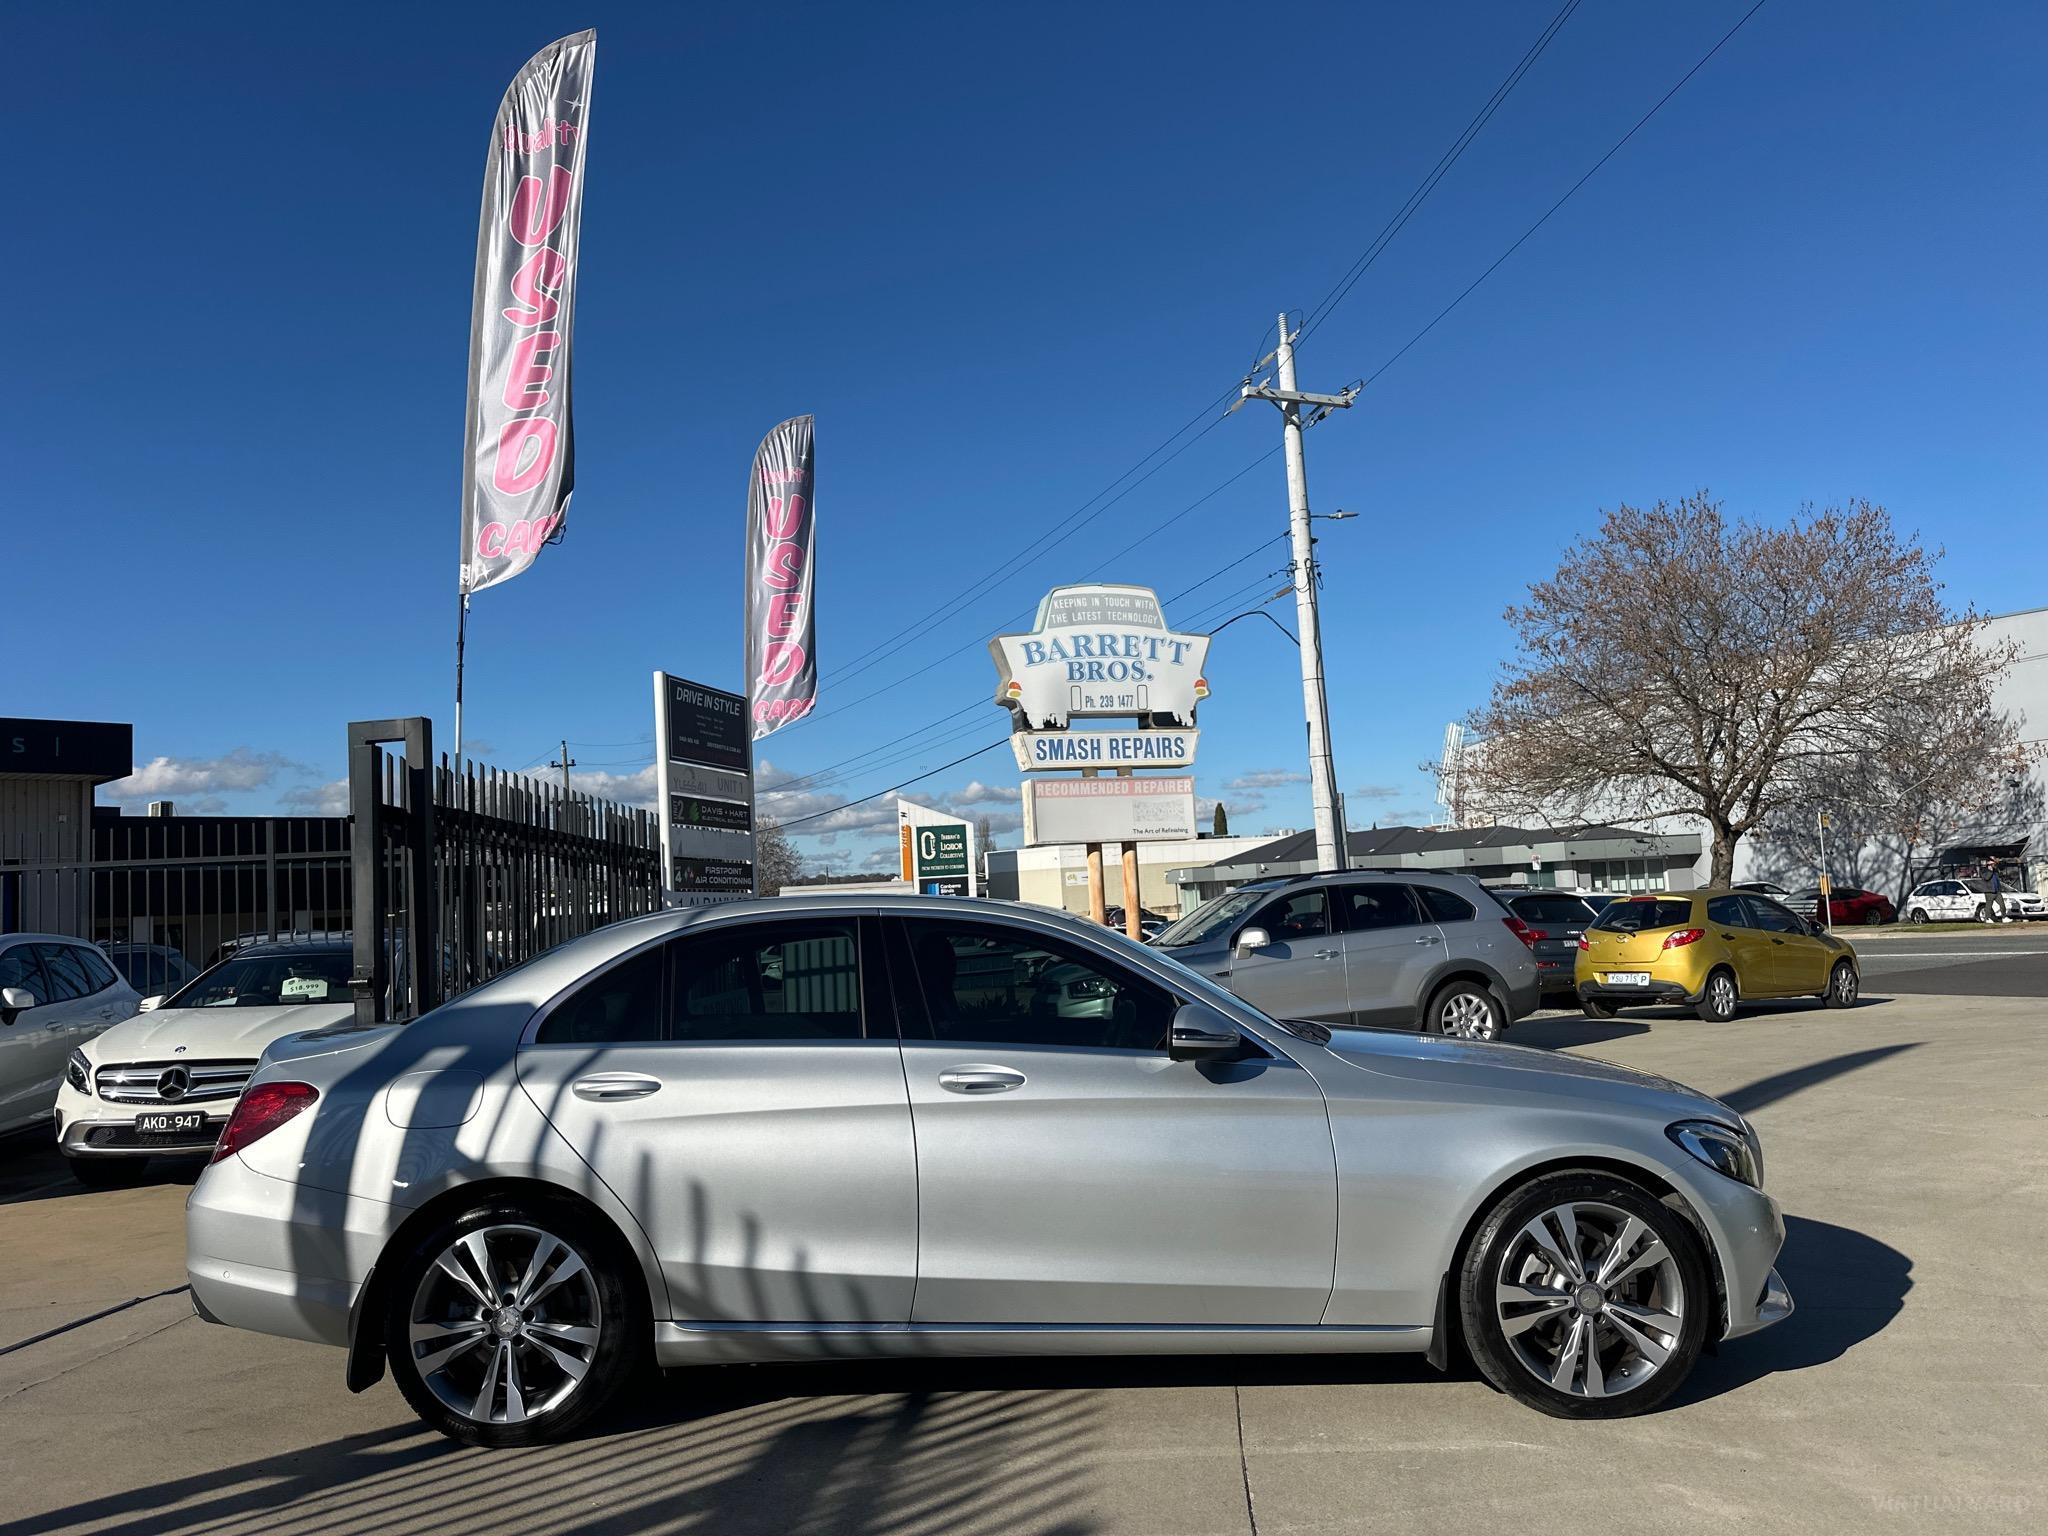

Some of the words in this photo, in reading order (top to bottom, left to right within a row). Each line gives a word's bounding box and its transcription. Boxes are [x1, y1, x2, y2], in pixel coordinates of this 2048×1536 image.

[493, 164, 573, 497] USED
[762, 494, 806, 686] USED
[1054, 597, 1087, 609] KEEPING
[1092, 597, 1100, 606] IN
[1104, 597, 1130, 608] TOUCH
[1135, 600, 1154, 610] WITH
[1051, 613, 1067, 624] THE
[1072, 611, 1101, 622] LATEST
[1107, 612, 1158, 625] TECHNOLOGY
[1021, 633, 1191, 667] BARRETT
[1066, 660, 1155, 682] BROS.
[676, 687, 703, 706] DRIVE
[704, 694, 713, 709] IN
[713, 697, 741, 716] STYLE
[1100, 695, 1114, 708] 239
[1117, 694, 1134, 708] 1477
[1036, 738, 1101, 761] SMASH
[1109, 736, 1185, 760] REPAIRS
[717, 777, 738, 794] UNIT
[1037, 781, 1128, 796] RECOMMENDED
[1134, 780, 1191, 794] REPAIRER
[701, 806, 723, 815] DAVIS
[729, 809, 748, 818] HART
[705, 866, 742, 874] FIRSTPOINT
[695, 876, 708, 884] AIR
